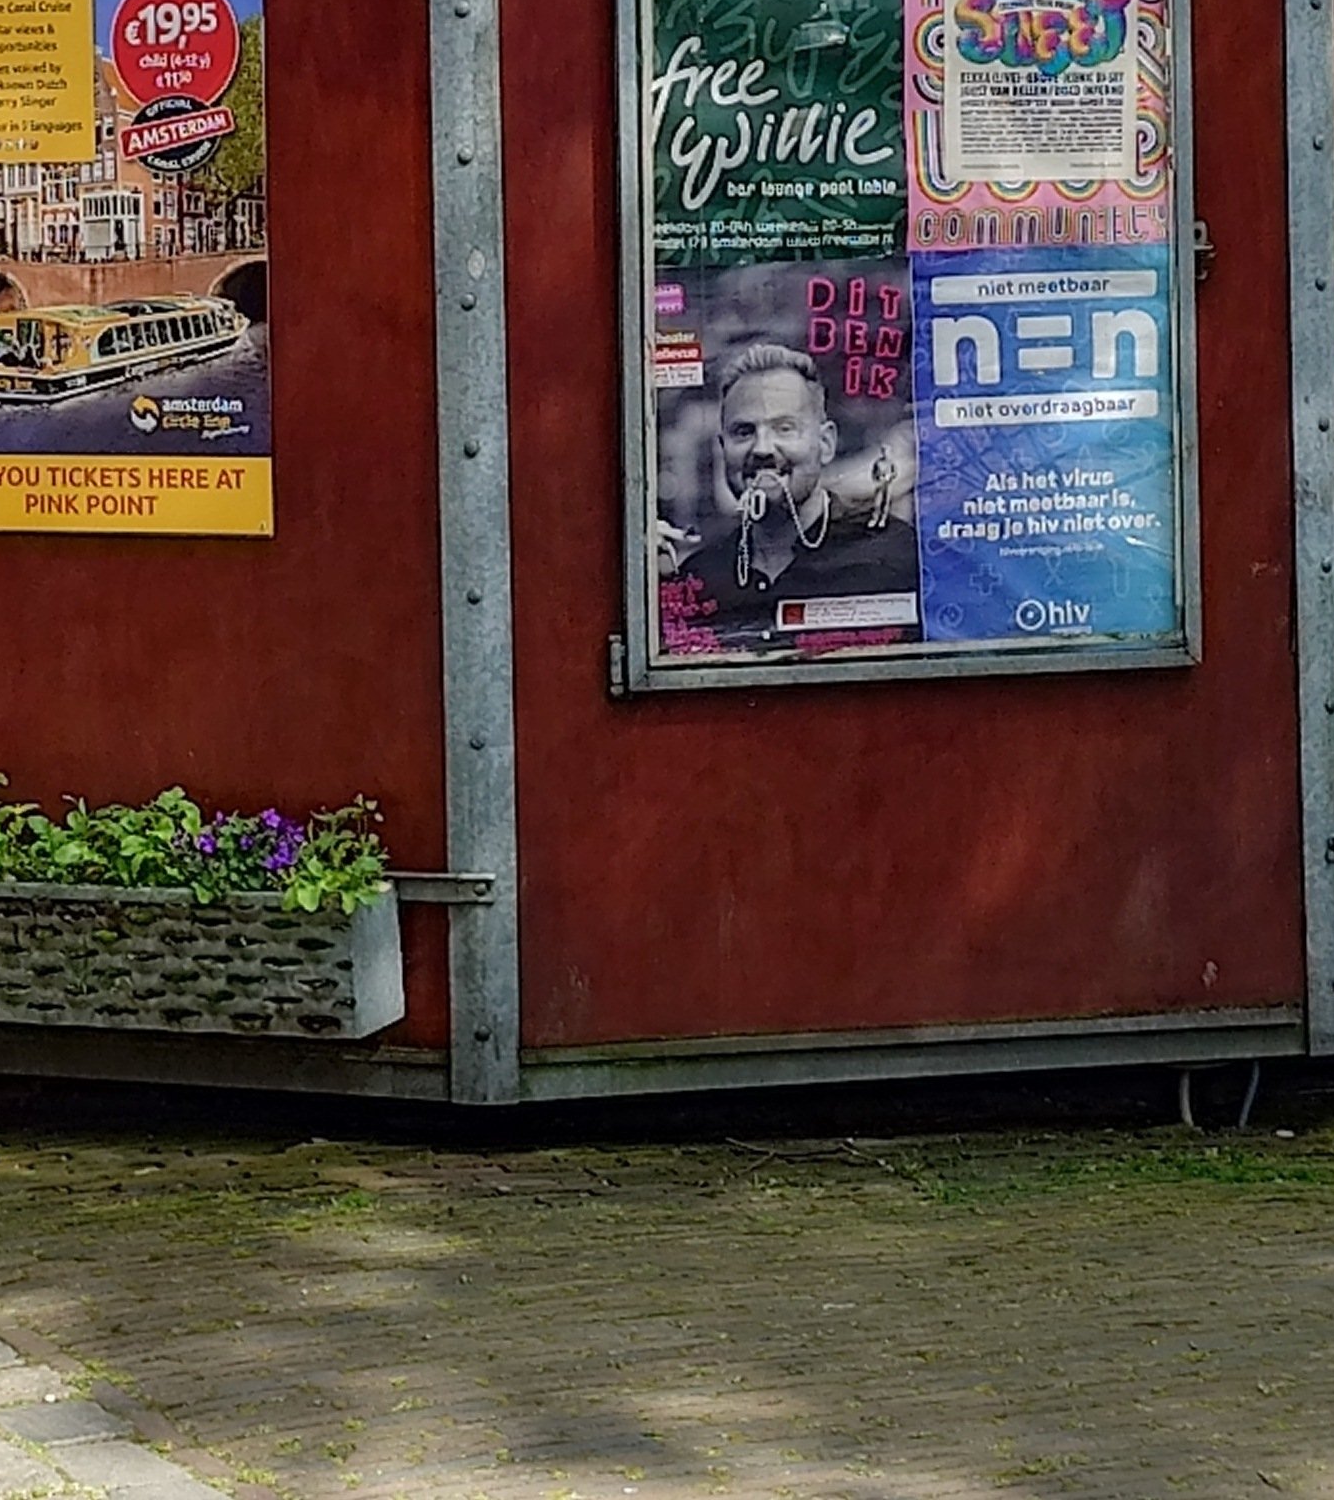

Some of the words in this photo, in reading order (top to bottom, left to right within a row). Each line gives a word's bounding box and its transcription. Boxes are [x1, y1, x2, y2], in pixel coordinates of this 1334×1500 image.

[7, 1, 36, 13] Canal
[38, 0, 72, 13] Cruise
[15, 24, 44, 35] views
[124, 2, 218, 50] €19,95
[650, 35, 780, 150] free
[128, 112, 227, 153] AMSTERDAM
[726, 180, 756, 197] bar
[761, 179, 815, 199] lounge
[819, 179, 854, 198] pool
[977, 279, 1015, 297] niet
[1018, 277, 1111, 295] meetbaar
[655, 331, 696, 344] heater
[809, 316, 904, 359] BEN
[161, 396, 243, 413] amsterdam
[955, 402, 994, 420] niet
[998, 397, 1137, 420] overdraagbaar
[45, 467, 142, 488] TICKETS
[148, 468, 210, 489] HERE
[216, 468, 246, 490] AT
[985, 473, 1018, 492] Als
[1021, 471, 1057, 489] het
[1061, 469, 1114, 487] virus
[24, 494, 79, 515] PINK
[86, 495, 159, 516] POINT
[963, 497, 1008, 517] niet
[1009, 495, 1111, 514] meetbaar
[937, 518, 1000, 542] draag
[1001, 518, 1023, 541] je
[1027, 515, 1059, 535] hiv
[1062, 513, 1106, 533] niet
[1108, 512, 1161, 531] over.
